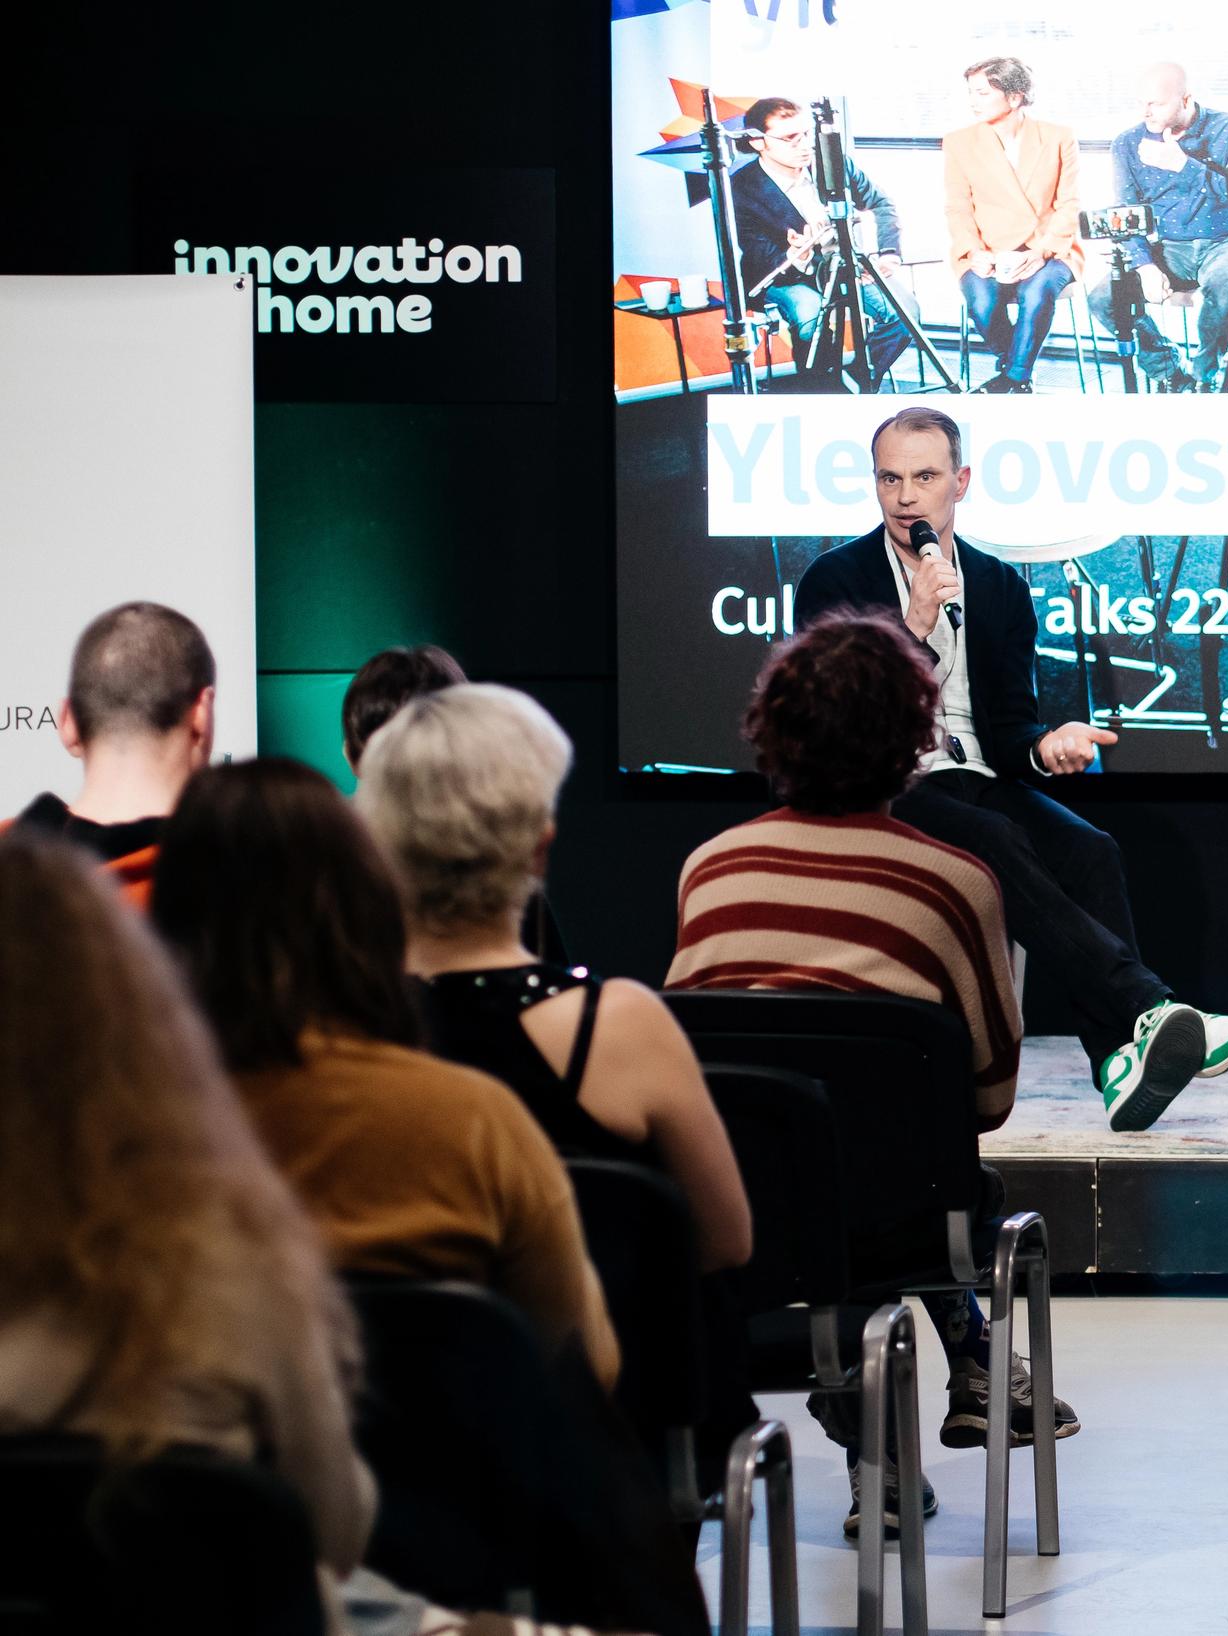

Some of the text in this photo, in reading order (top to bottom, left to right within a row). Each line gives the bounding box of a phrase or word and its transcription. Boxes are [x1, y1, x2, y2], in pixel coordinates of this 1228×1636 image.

[174, 238, 522, 284] innovation
[257, 287, 433, 333] home
[706, 415, 872, 505] Yle
[1029, 581, 1157, 635] alks
